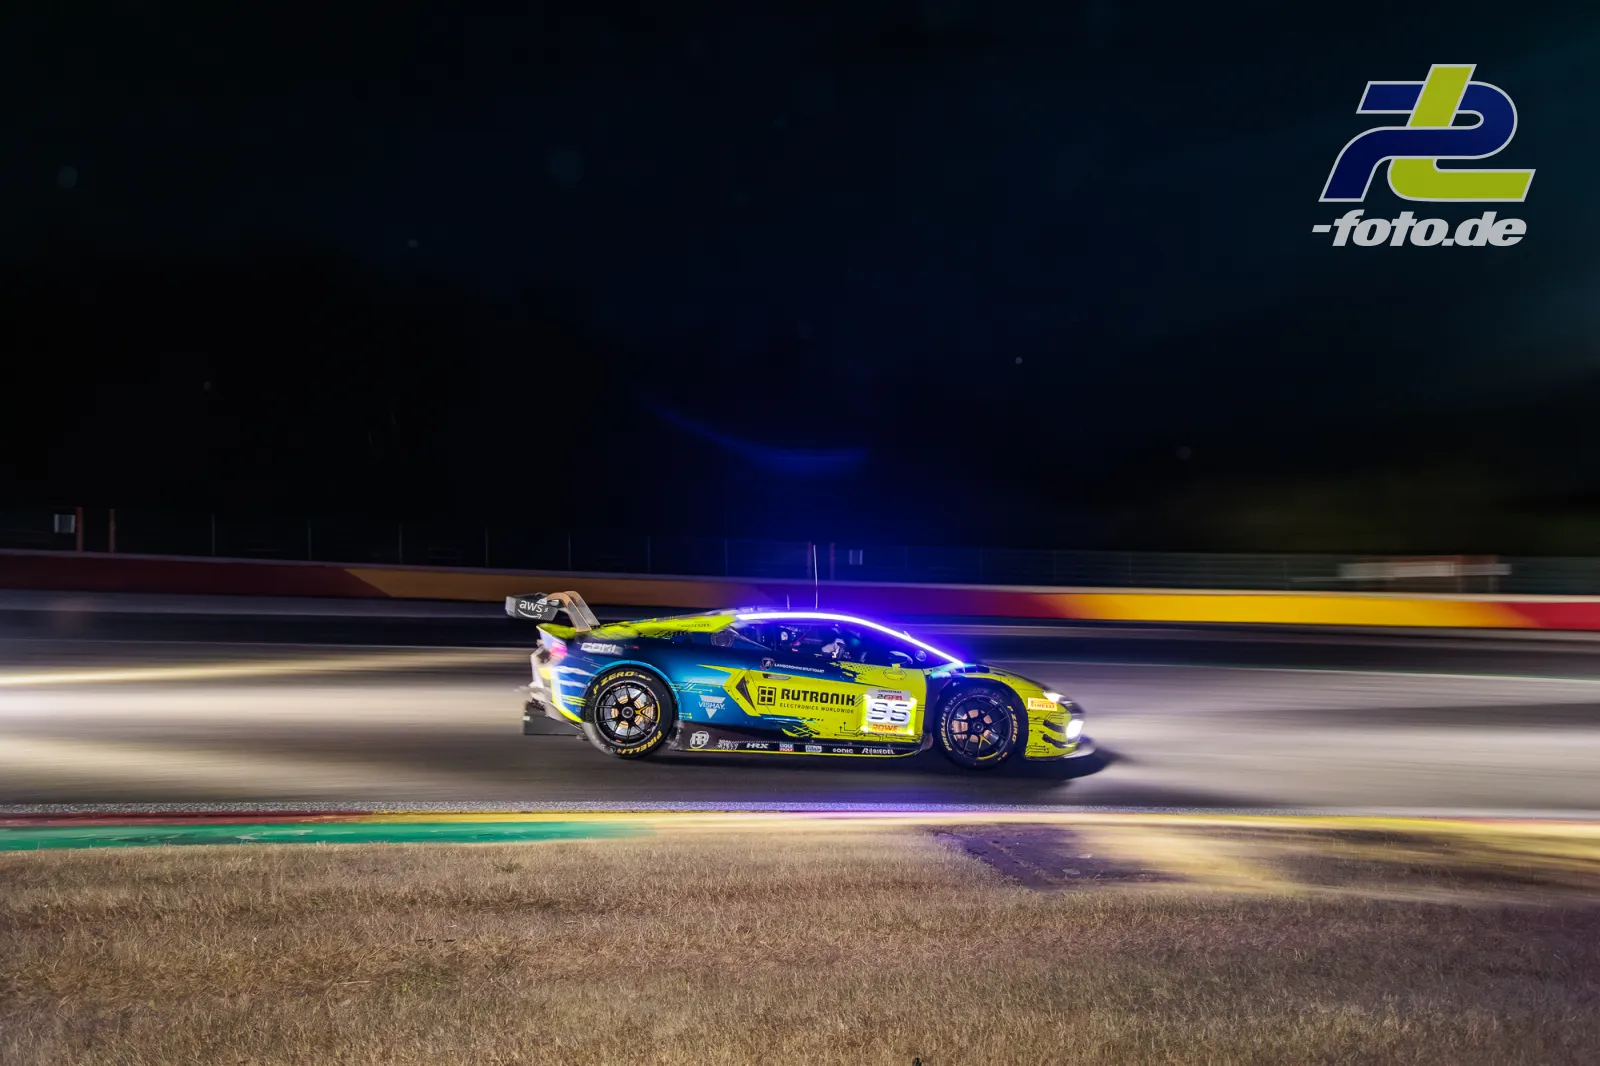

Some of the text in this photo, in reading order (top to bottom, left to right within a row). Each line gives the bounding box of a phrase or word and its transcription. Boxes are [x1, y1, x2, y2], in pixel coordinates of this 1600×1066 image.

[519, 600, 544, 613] aws
[593, 671, 635, 694] P ZERO
[781, 688, 856, 706] RUTRONIK
[698, 701, 726, 709] VISHAY
[780, 702, 854, 714] ELECTRONICS WORLDWIDE
[872, 723, 898, 733] ROWE
[621, 730, 662, 754] PIRELLI
